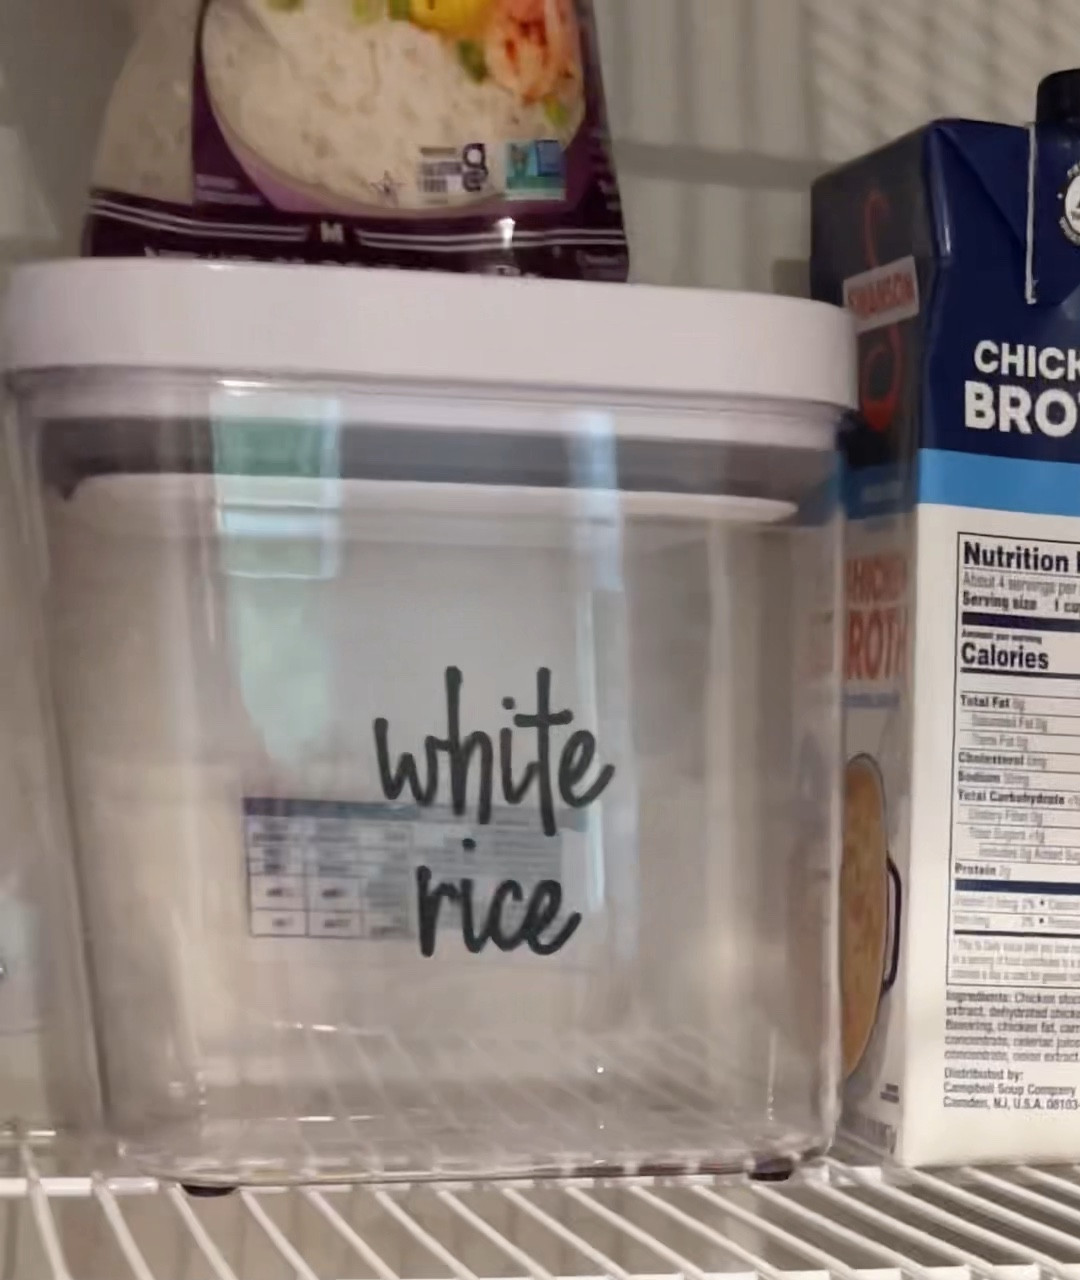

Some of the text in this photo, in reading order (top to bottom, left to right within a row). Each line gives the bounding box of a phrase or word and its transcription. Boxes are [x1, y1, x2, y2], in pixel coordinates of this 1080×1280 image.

[963, 541, 1069, 573] Nutrition
[963, 590, 1009, 611] Serving
[960, 642, 1050, 670] Calories
[960, 695, 989, 708] Total
[374, 665, 615, 836] white
[416, 837, 581, 957] rice
